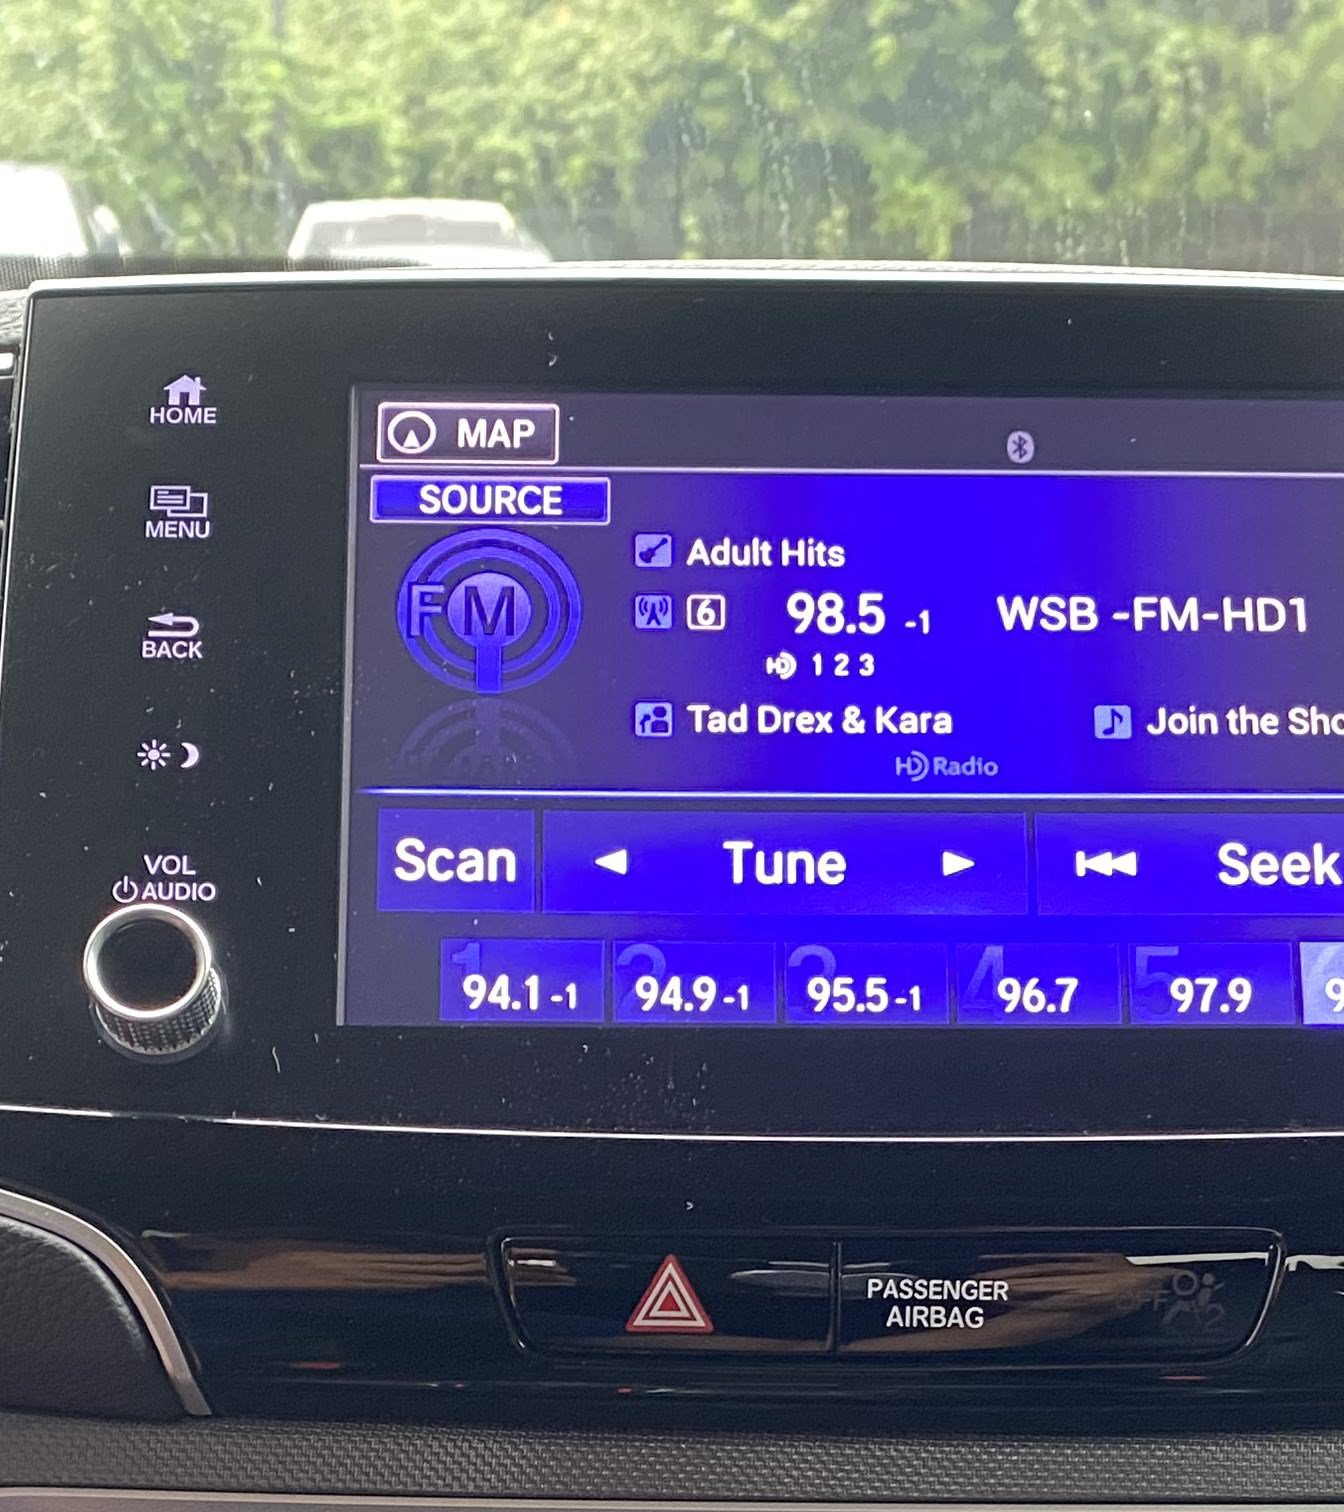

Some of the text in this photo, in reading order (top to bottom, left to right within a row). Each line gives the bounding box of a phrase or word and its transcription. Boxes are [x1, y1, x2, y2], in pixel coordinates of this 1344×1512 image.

[150, 408, 217, 424] HOME
[457, 418, 535, 450] MAP
[419, 484, 563, 516] SOURCE
[145, 521, 211, 538] MENU
[687, 539, 845, 567] Adult Hits
[696, 600, 716, 626] 6
[787, 592, 886, 635] 98.5
[997, 595, 1098, 632] WSB
[142, 641, 204, 658] BACK
[686, 704, 953, 734] Tad Drex & Kara
[1147, 706, 1218, 735] Join
[1226, 706, 1279, 735] the
[933, 756, 999, 777] Radio
[144, 855, 196, 875] VOL
[393, 837, 517, 882] Scan
[722, 841, 847, 885] Tune
[1217, 842, 1344, 885] Seek
[141, 883, 216, 901] AUDIO
[997, 976, 1079, 1013] 96.7
[1170, 976, 1252, 1013] 97.9
[867, 1278, 1009, 1302] PASSENGER
[886, 1305, 985, 1329] AIRBAG
